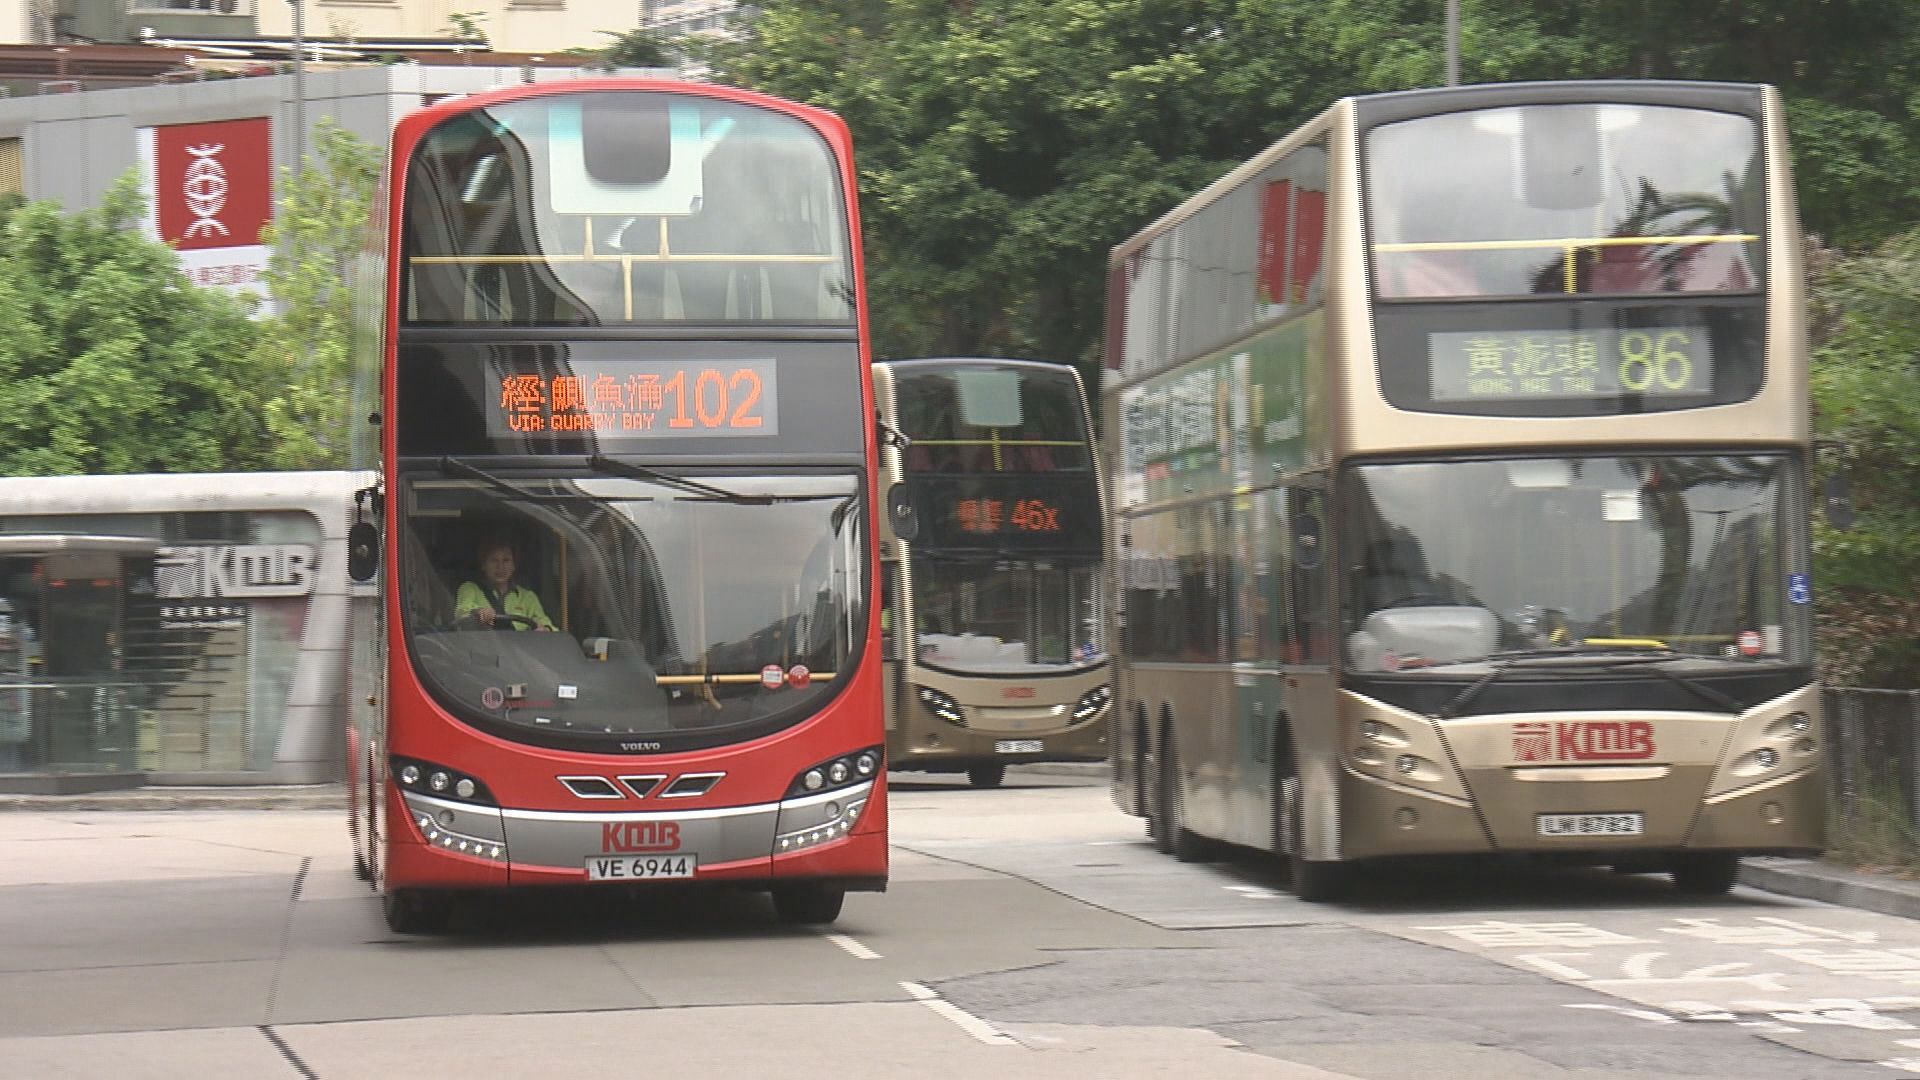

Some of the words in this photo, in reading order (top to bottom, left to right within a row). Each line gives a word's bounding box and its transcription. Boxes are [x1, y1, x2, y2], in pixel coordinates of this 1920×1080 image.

[1618, 331, 1692, 391] 86
[664, 369, 764, 428] 102
[550, 413, 616, 431] QUARRY
[622, 413, 655, 430] BAY
[621, 742, 661, 750] VOLVO
[1556, 721, 1657, 761] KMB
[602, 821, 681, 853] KMB
[1545, 816, 1576, 833] LM
[596, 859, 623, 877] VE
[632, 858, 687, 876] 6944
